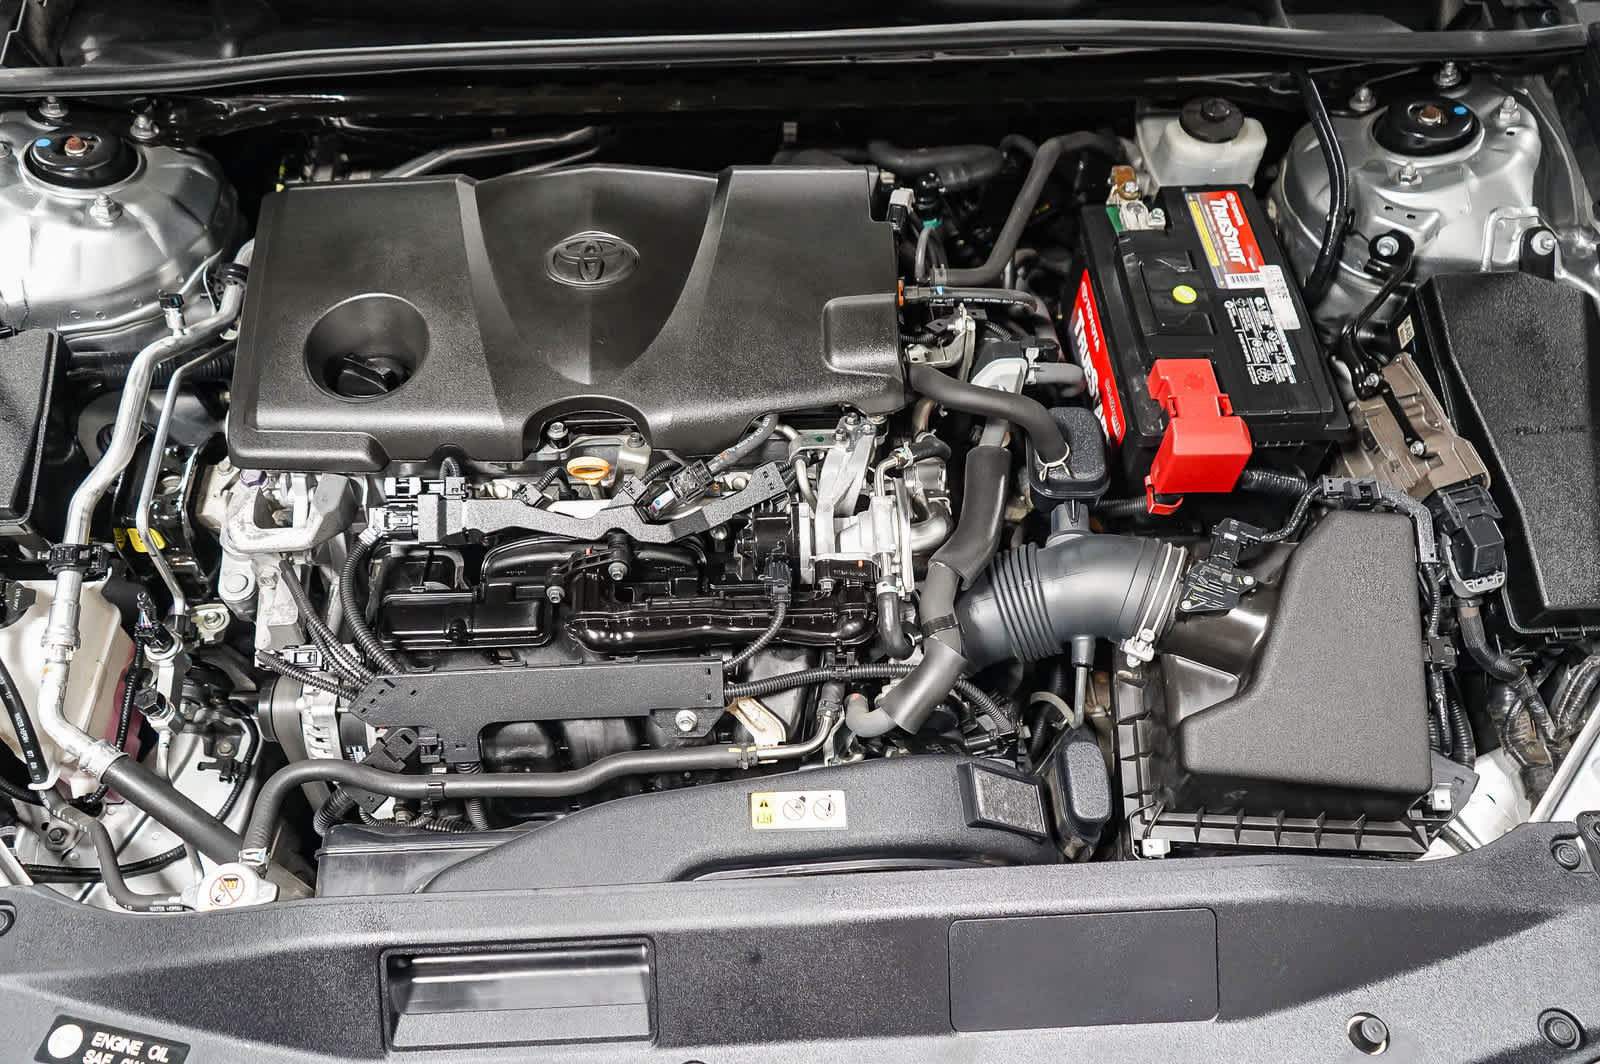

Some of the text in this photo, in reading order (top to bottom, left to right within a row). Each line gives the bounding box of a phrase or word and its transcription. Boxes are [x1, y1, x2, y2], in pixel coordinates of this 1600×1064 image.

[1086, 300, 1101, 353] TOYOTA
[82, 1048, 115, 1064] SAE
[91, 1031, 169, 1063] ENGINE OIL
